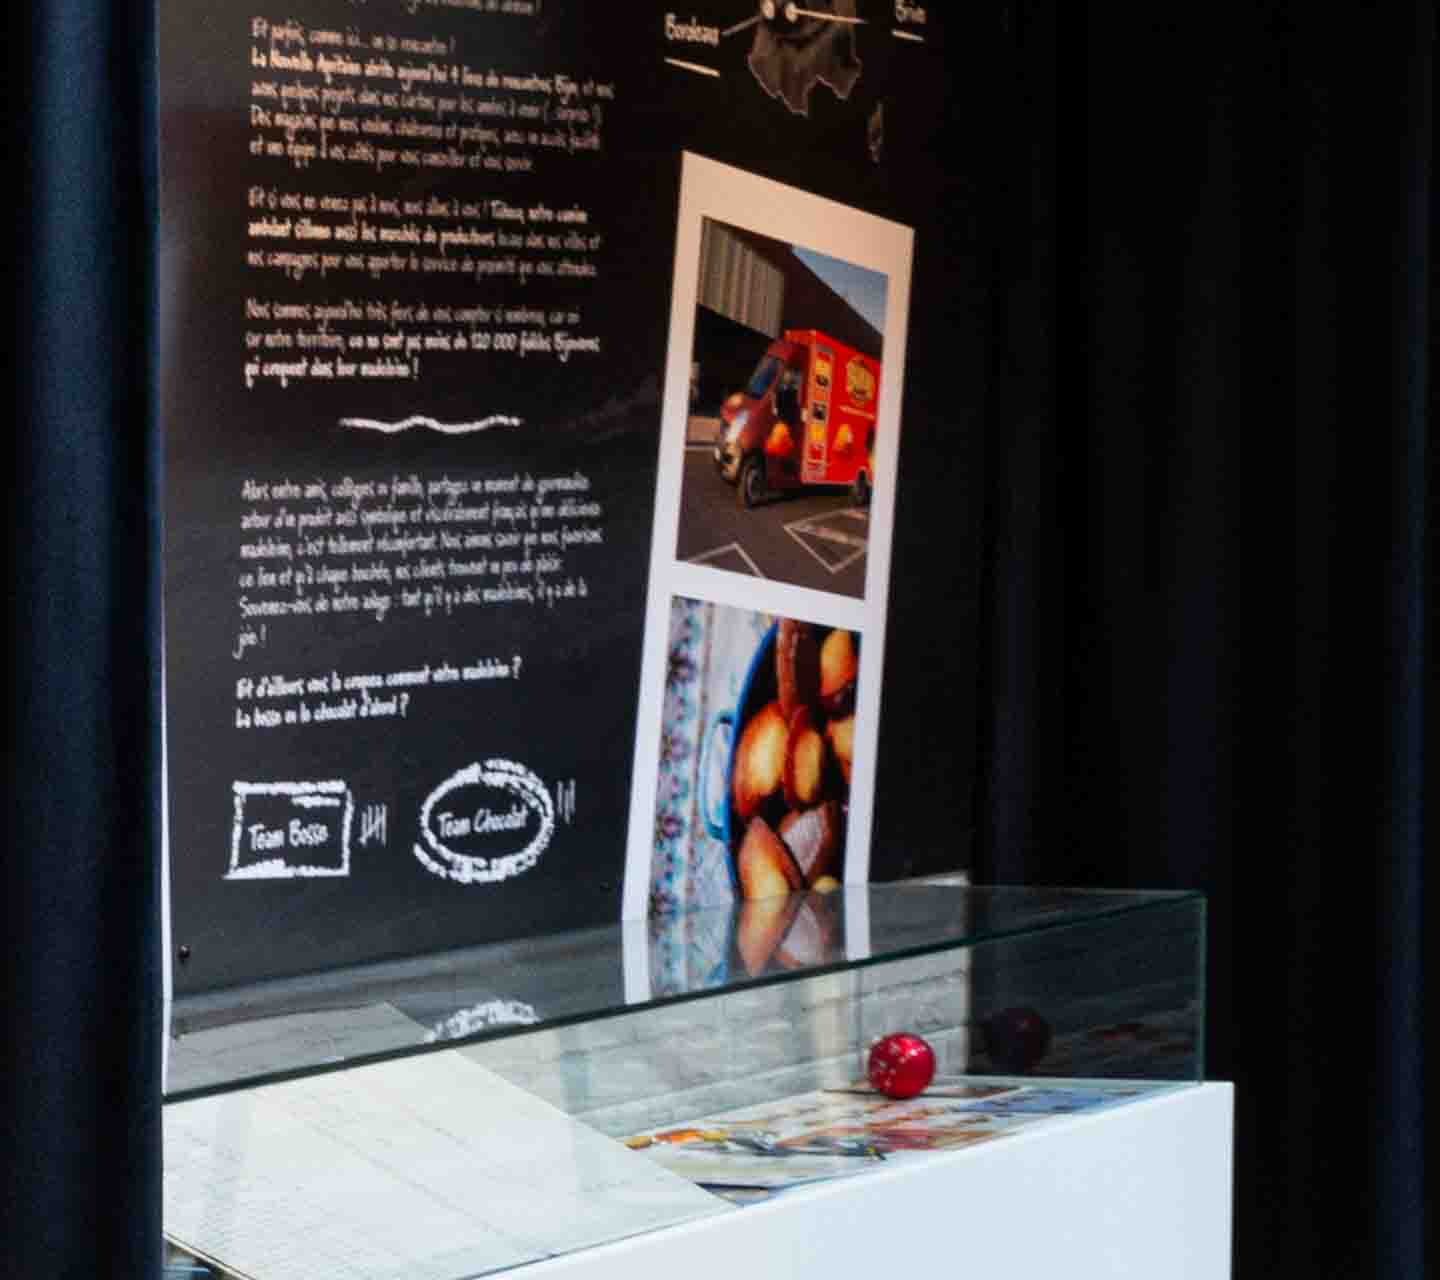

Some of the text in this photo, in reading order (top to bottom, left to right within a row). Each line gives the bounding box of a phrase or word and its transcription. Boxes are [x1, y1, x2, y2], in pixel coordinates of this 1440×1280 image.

[248, 819, 329, 852] Team Bosse
[437, 803, 528, 838] Team Chocolat
